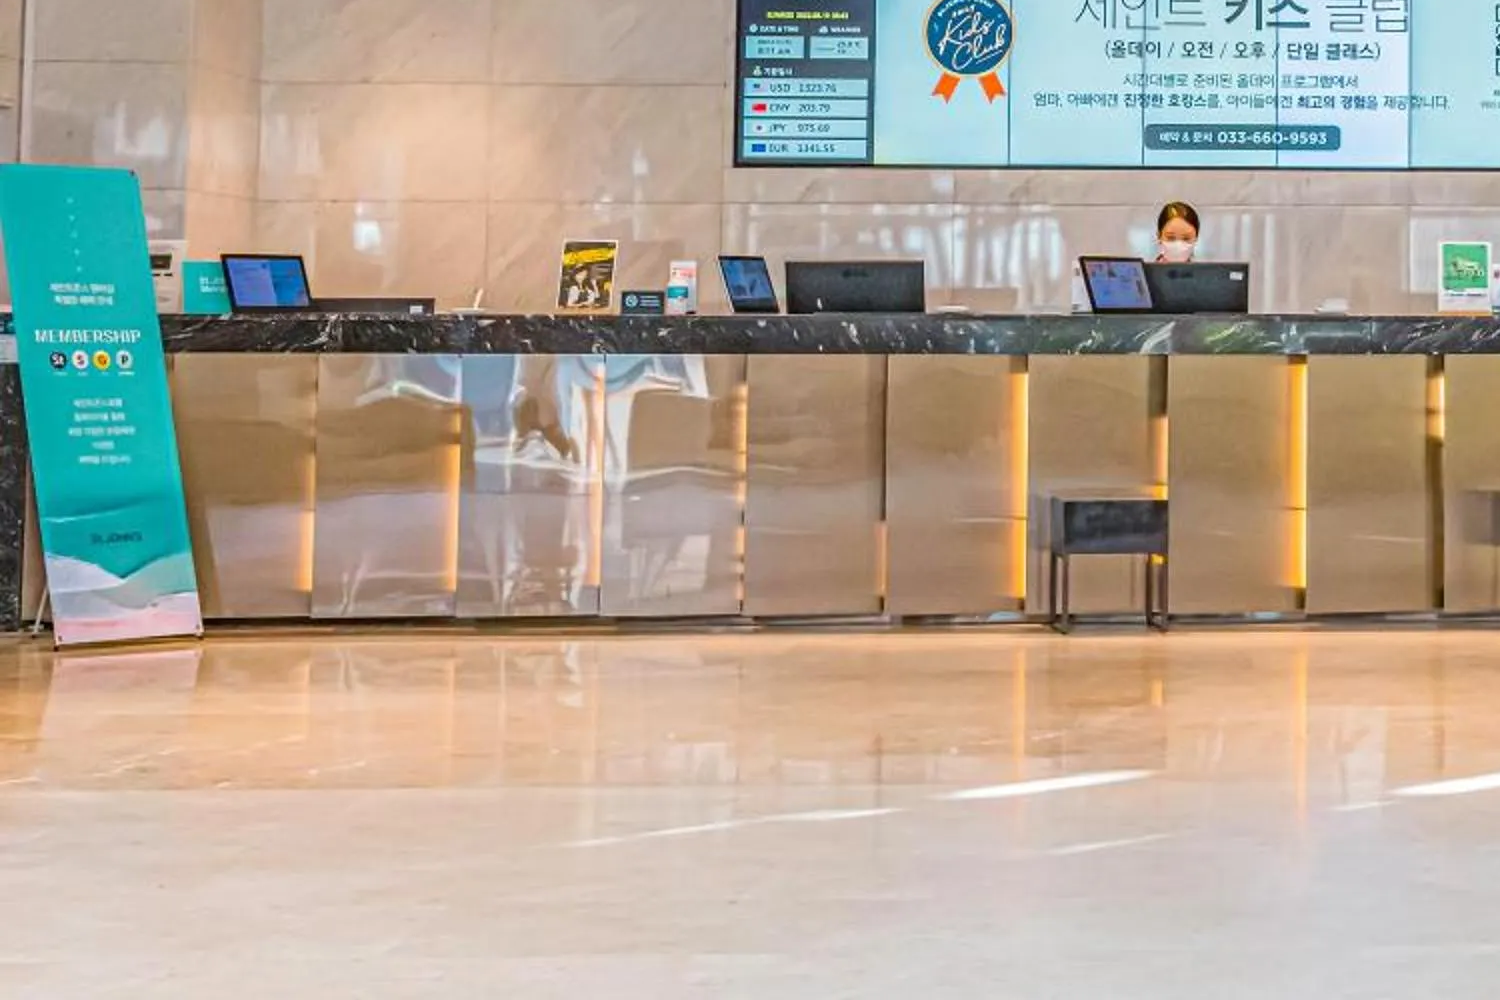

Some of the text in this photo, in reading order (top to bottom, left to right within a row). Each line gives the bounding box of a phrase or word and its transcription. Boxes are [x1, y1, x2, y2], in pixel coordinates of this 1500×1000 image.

[952, 24, 1006, 70] Club
[1105, 40, 1161, 59] (올데이
[1181, 41, 1214, 59] 오전
[1232, 41, 1266, 59] 오후
[1287, 42, 1319, 60] 단일
[1325, 42, 1382, 60] 클래스)
[770, 83, 790, 93] USD
[1033, 93, 1063, 108] 엄마,
[1123, 93, 1164, 108] 진정한
[1297, 95, 1335, 109] 최고의
[1339, 95, 1378, 110] 경험을
[1182, 132, 1190, 143] &
[1217, 131, 1327, 145] 033-660-9593
[35, 329, 140, 343] MEMBERSHIP
